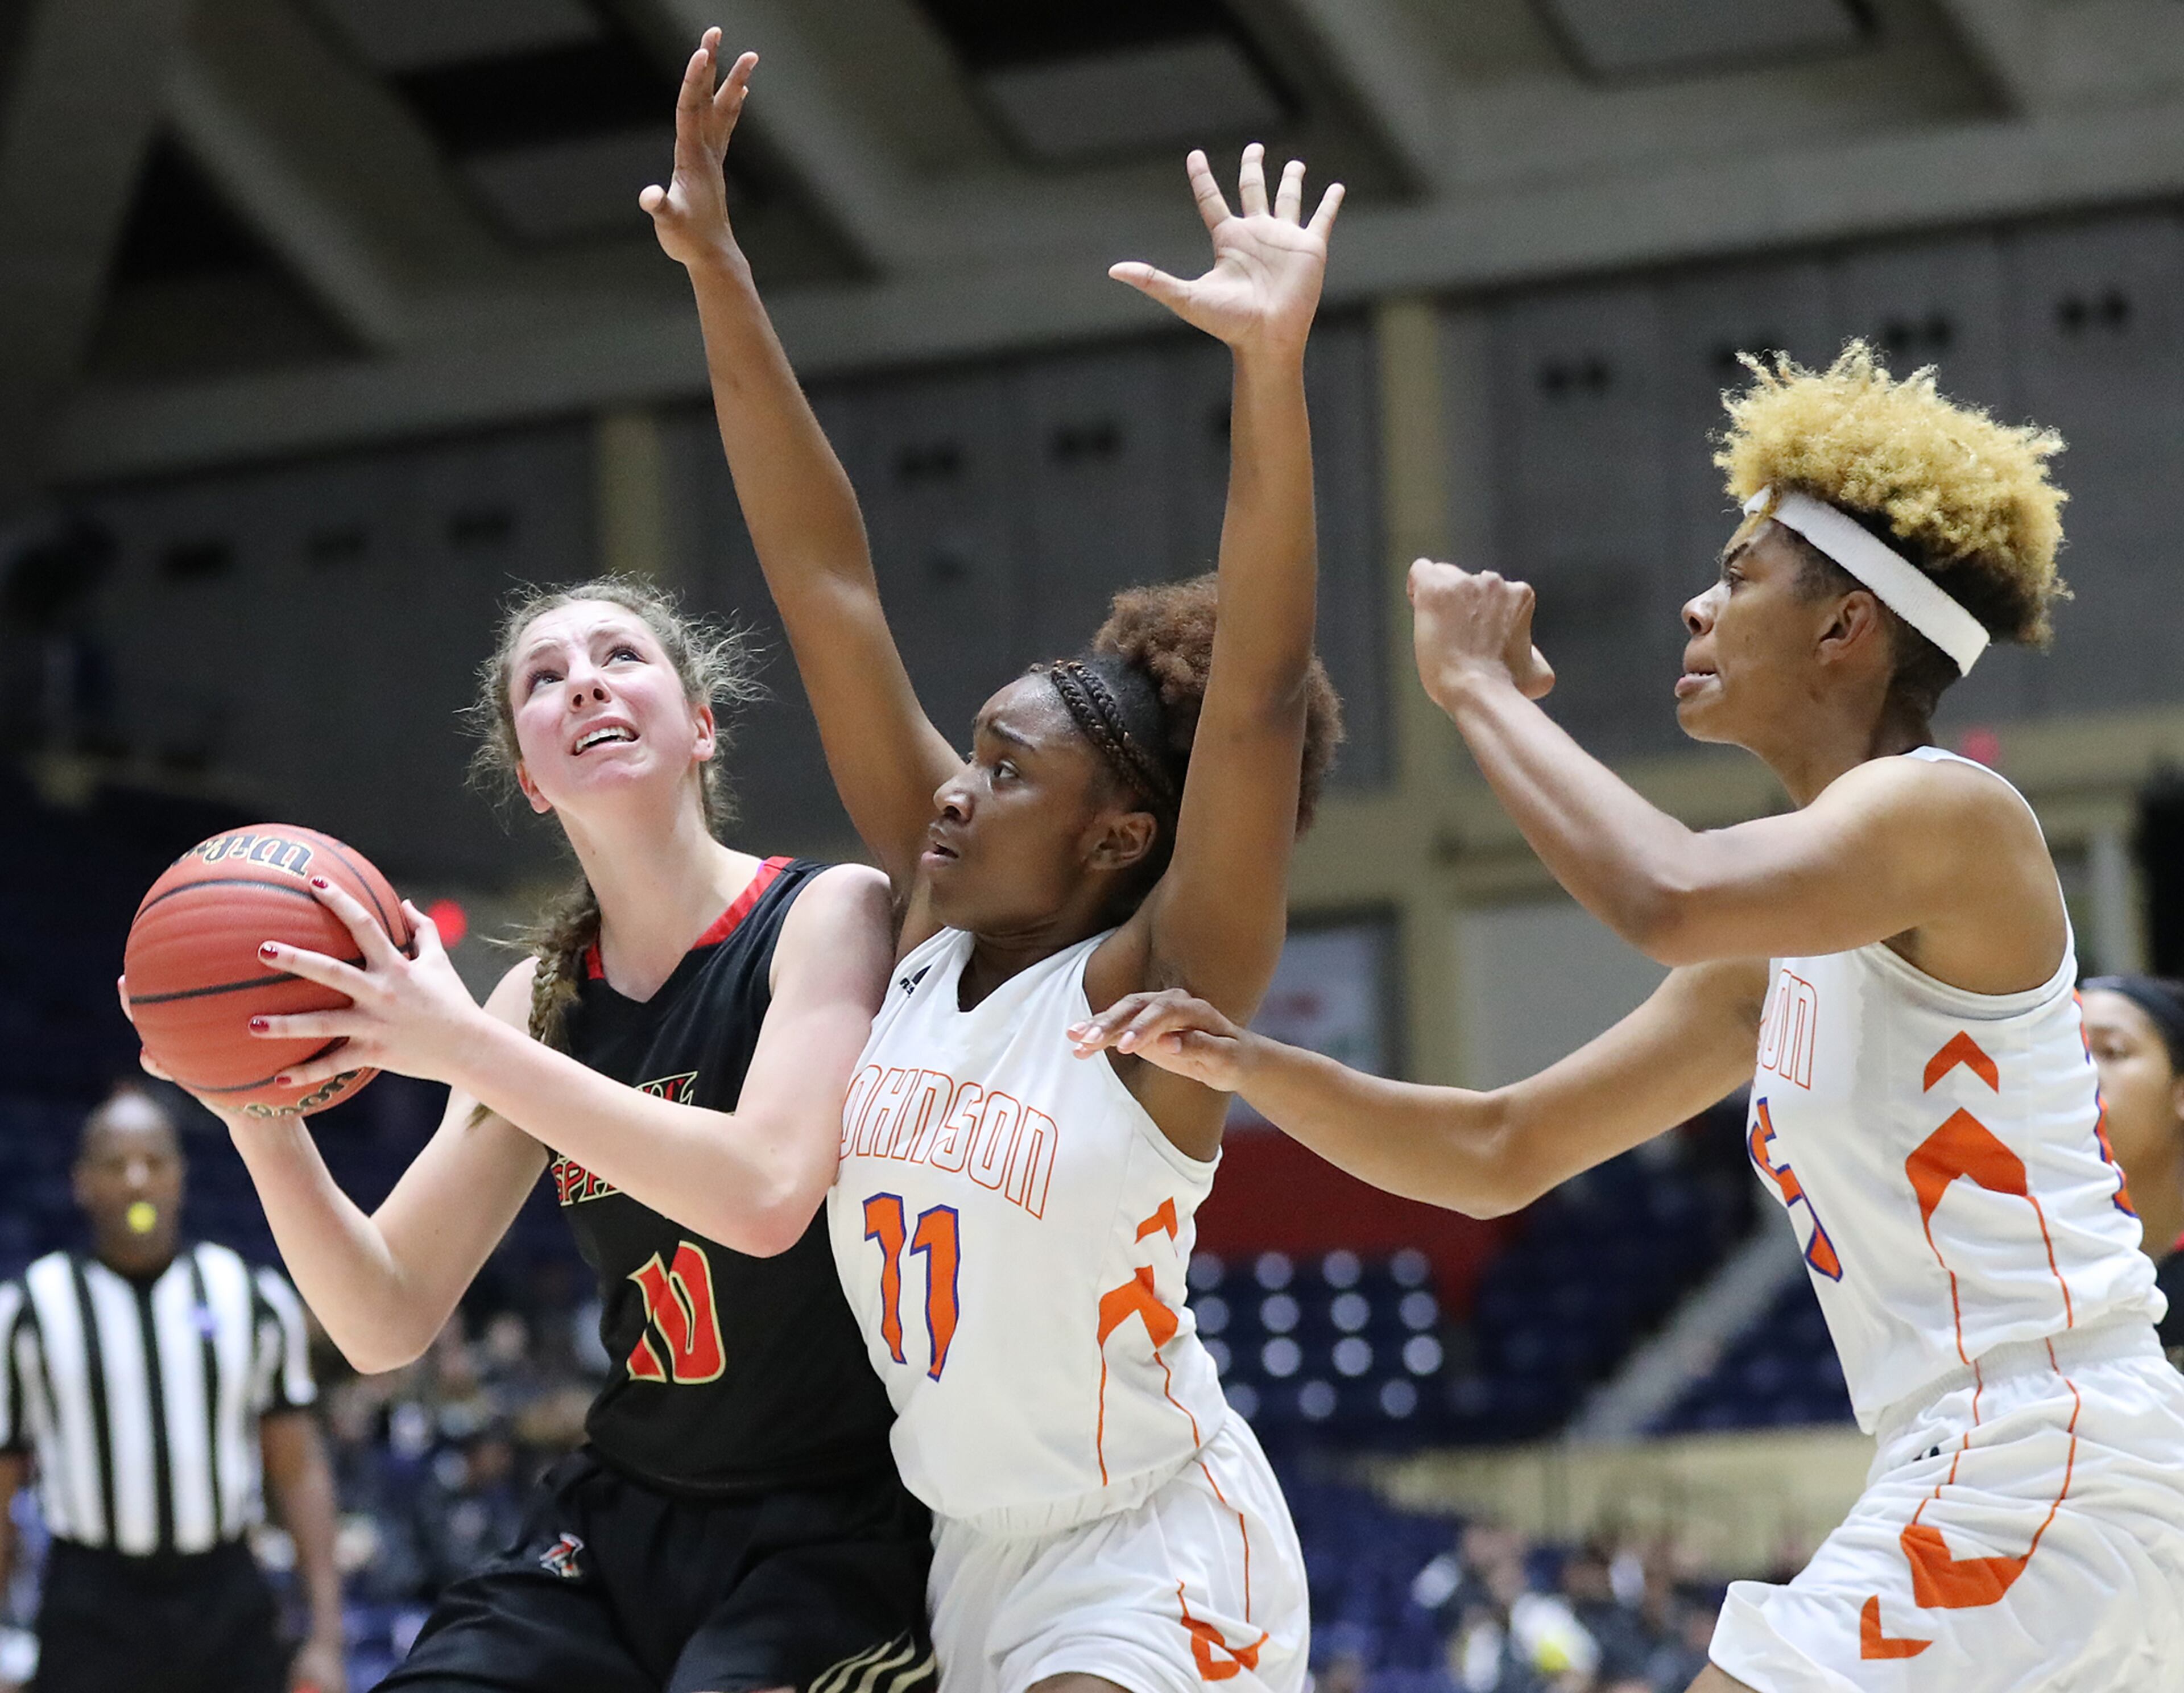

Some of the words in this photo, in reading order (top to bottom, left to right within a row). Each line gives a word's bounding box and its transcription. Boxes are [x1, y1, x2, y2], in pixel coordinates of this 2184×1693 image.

[838, 1064, 1058, 1220] OHNSON
[626, 1240, 726, 1385] 10
[862, 1191, 961, 1384] 11
